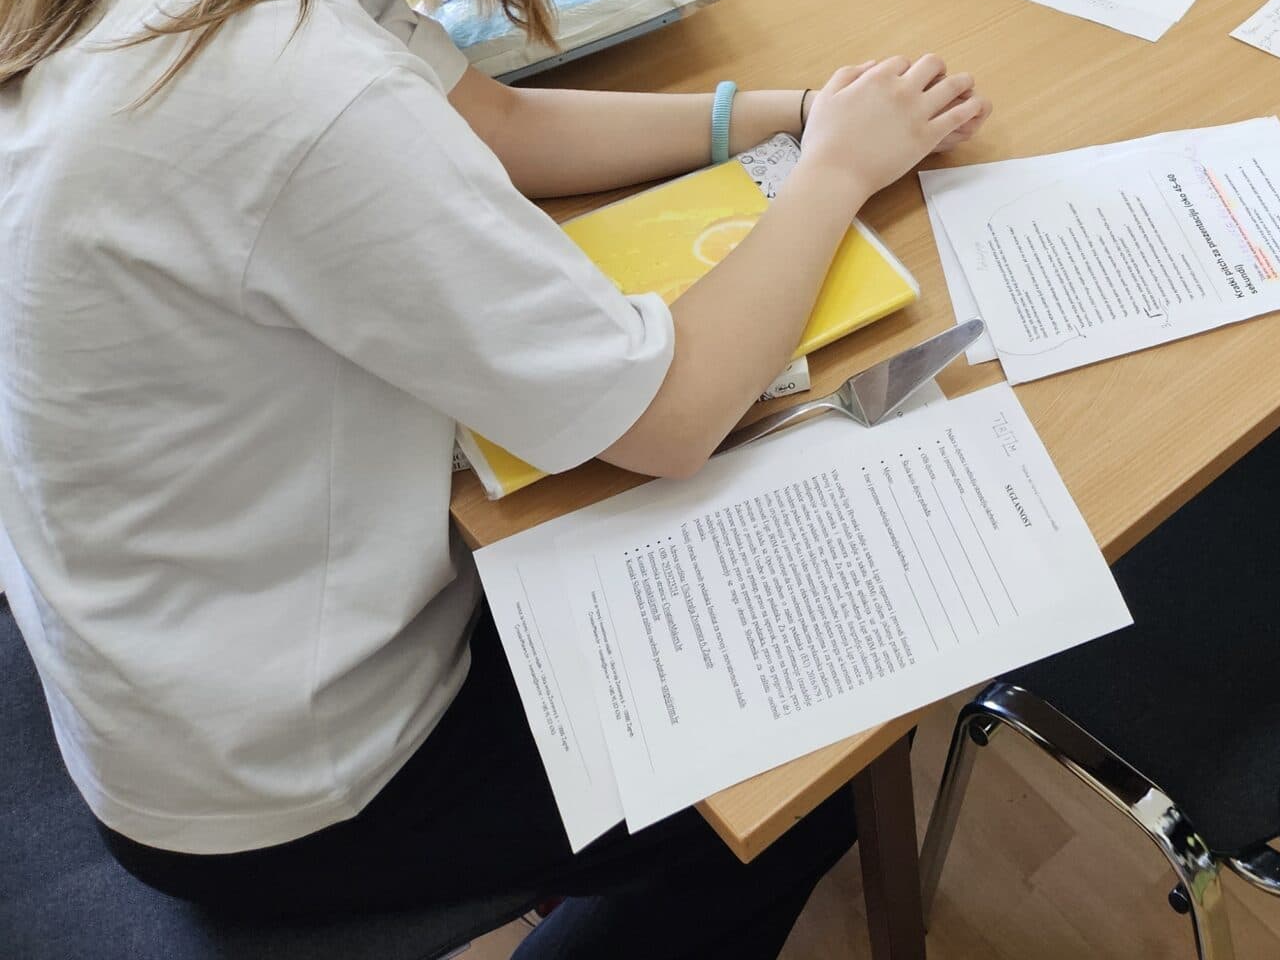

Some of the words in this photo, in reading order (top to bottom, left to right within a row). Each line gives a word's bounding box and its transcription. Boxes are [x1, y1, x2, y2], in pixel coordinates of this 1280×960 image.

[1177, 192, 1193, 207] (oko
[1186, 207, 1218, 248] prezentaciju
[1211, 248, 1221, 257] za
[1215, 257, 1233, 276] pitch
[1225, 276, 1245, 299] Kratki
[1233, 263, 1260, 295] sekundi)
[1004, 483, 1033, 529] SUGLASNOST
